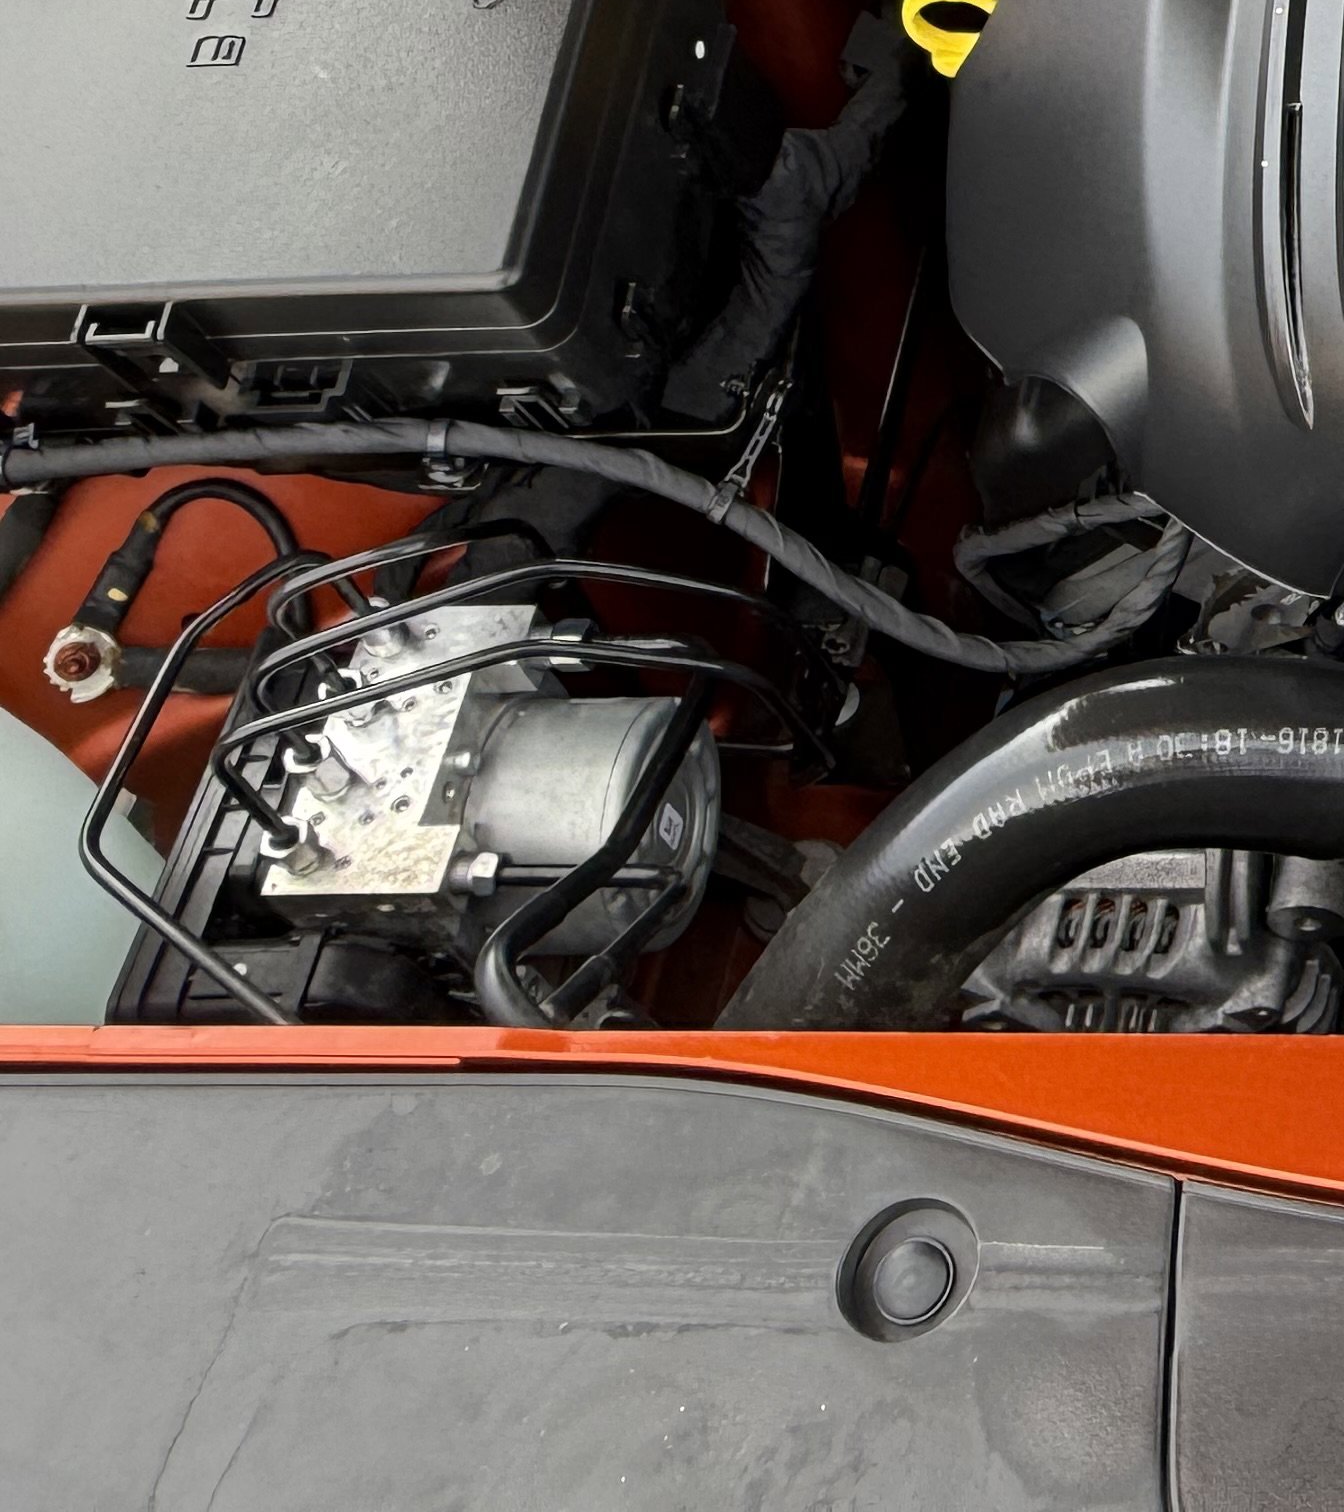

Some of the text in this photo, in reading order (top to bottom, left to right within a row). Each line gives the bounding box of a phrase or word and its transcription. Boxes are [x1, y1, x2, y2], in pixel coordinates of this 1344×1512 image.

[972, 788, 1029, 840] RAD
[913, 837, 962, 893] END
[833, 920, 891, 991] 36MM
